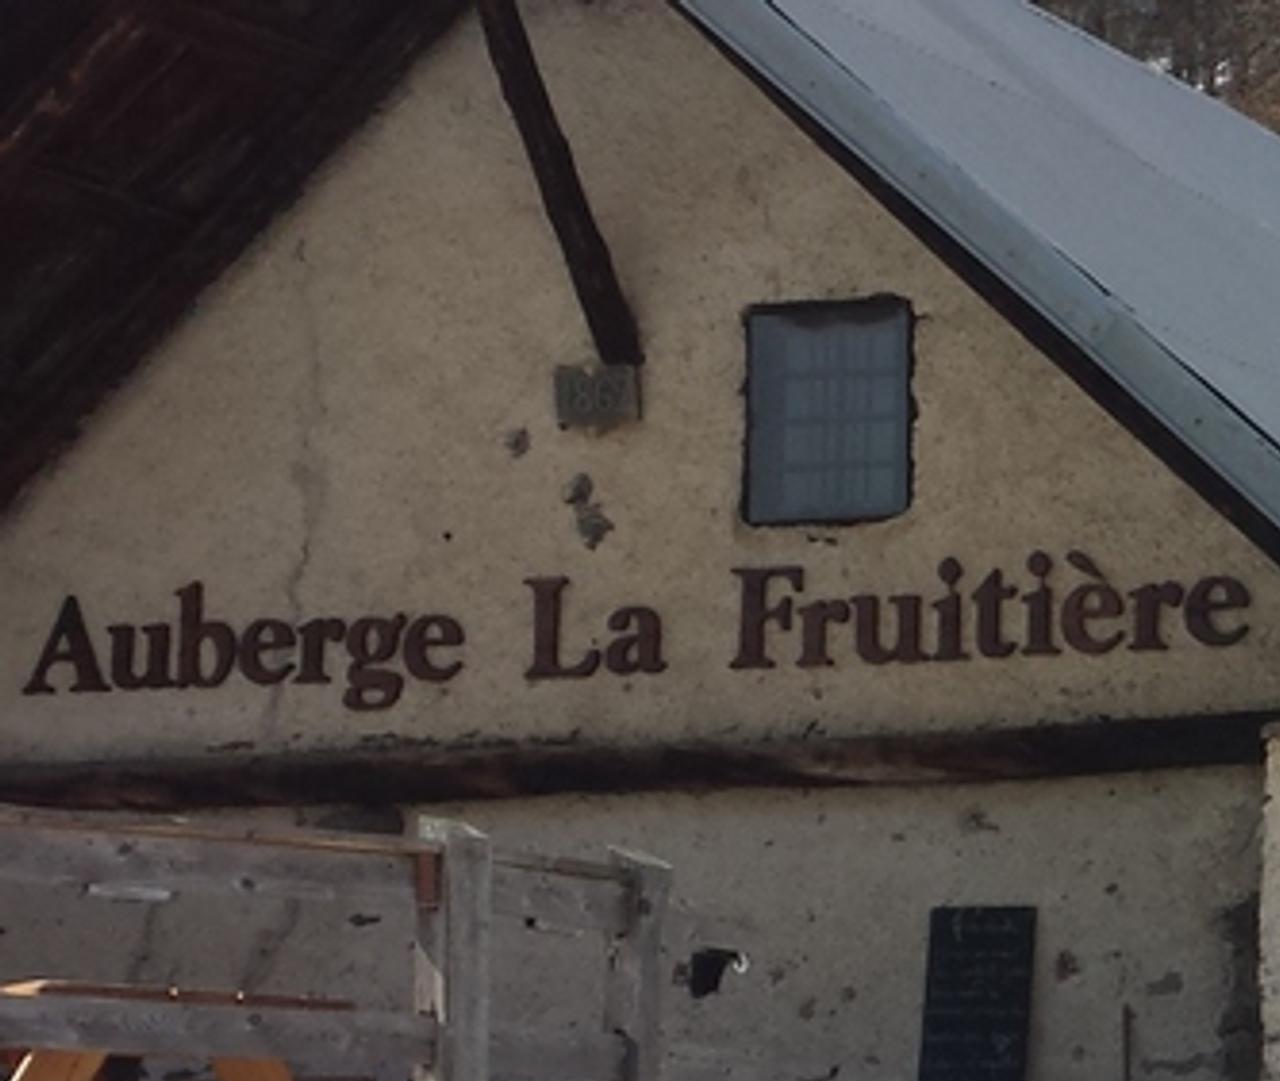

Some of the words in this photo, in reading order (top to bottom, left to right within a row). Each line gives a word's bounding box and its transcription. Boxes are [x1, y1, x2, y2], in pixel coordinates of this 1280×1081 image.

[22, 581, 465, 710] Auberge
[523, 576, 668, 680] La
[729, 550, 1251, 667] Fruitière
